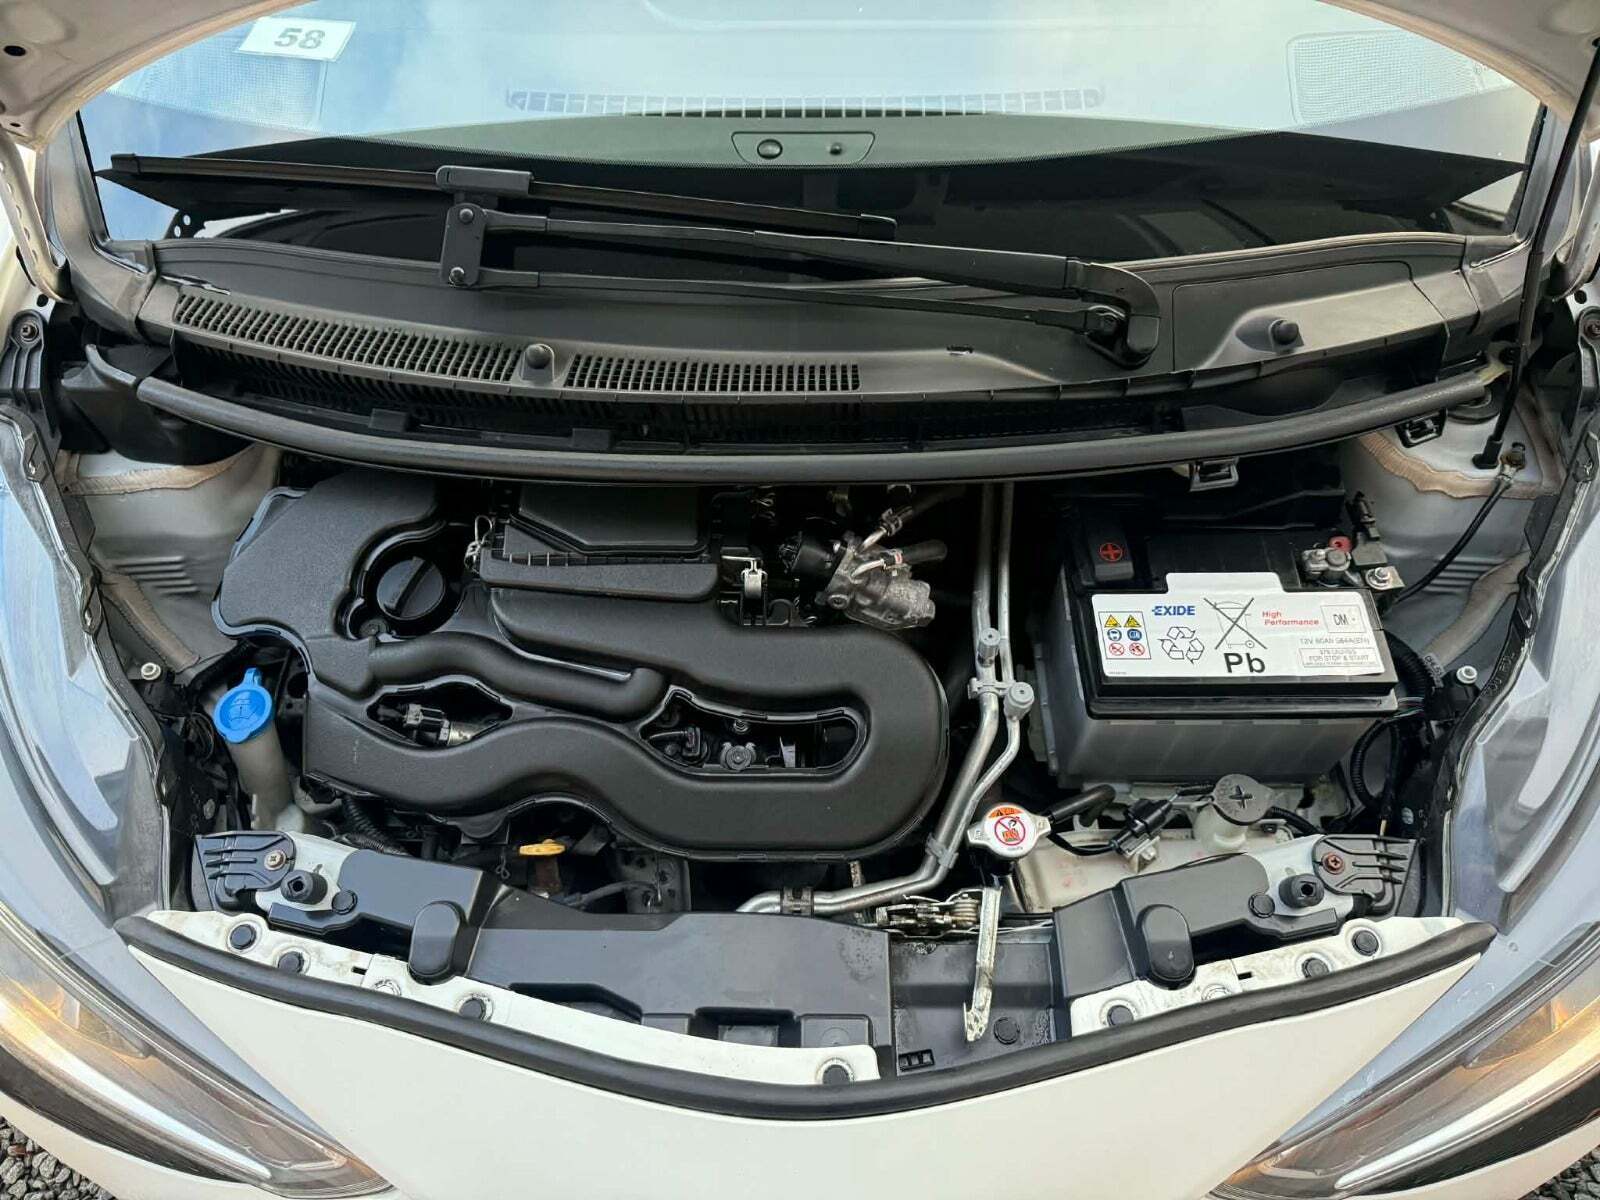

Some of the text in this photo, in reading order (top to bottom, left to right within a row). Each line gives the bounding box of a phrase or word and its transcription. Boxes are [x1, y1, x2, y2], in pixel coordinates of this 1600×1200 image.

[274, 28, 326, 49] 58
[1152, 605, 1196, 616] EXIDE
[1262, 611, 1282, 619] High
[1264, 618, 1319, 626] Performance
[1224, 652, 1266, 673] Pb
